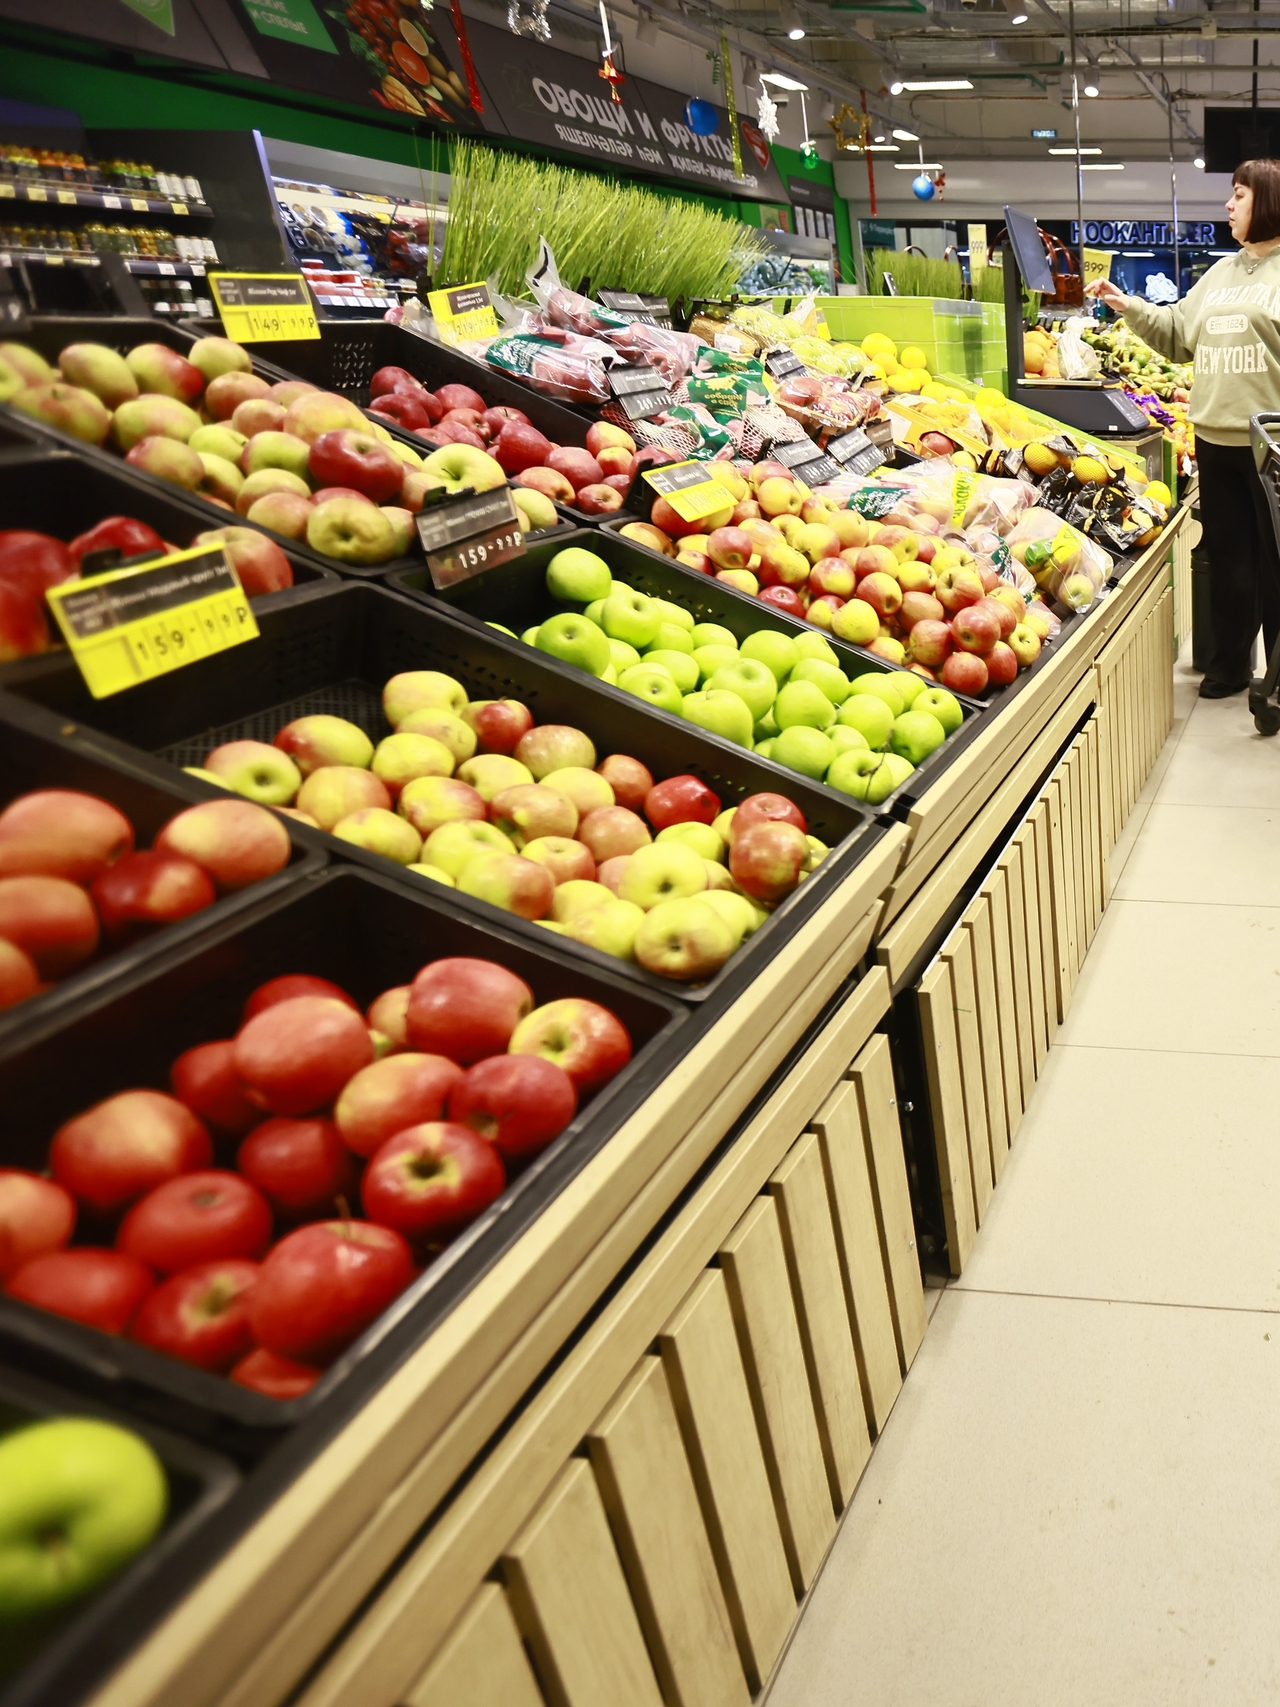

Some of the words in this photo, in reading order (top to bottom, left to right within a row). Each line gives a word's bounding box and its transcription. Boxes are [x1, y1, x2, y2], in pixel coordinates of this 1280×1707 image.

[532, 77, 635, 136] ОВОЩИ
[635, 109, 658, 142] И
[660, 117, 735, 162] ФРУКТЫ
[1222, 341, 1269, 374] YORK
